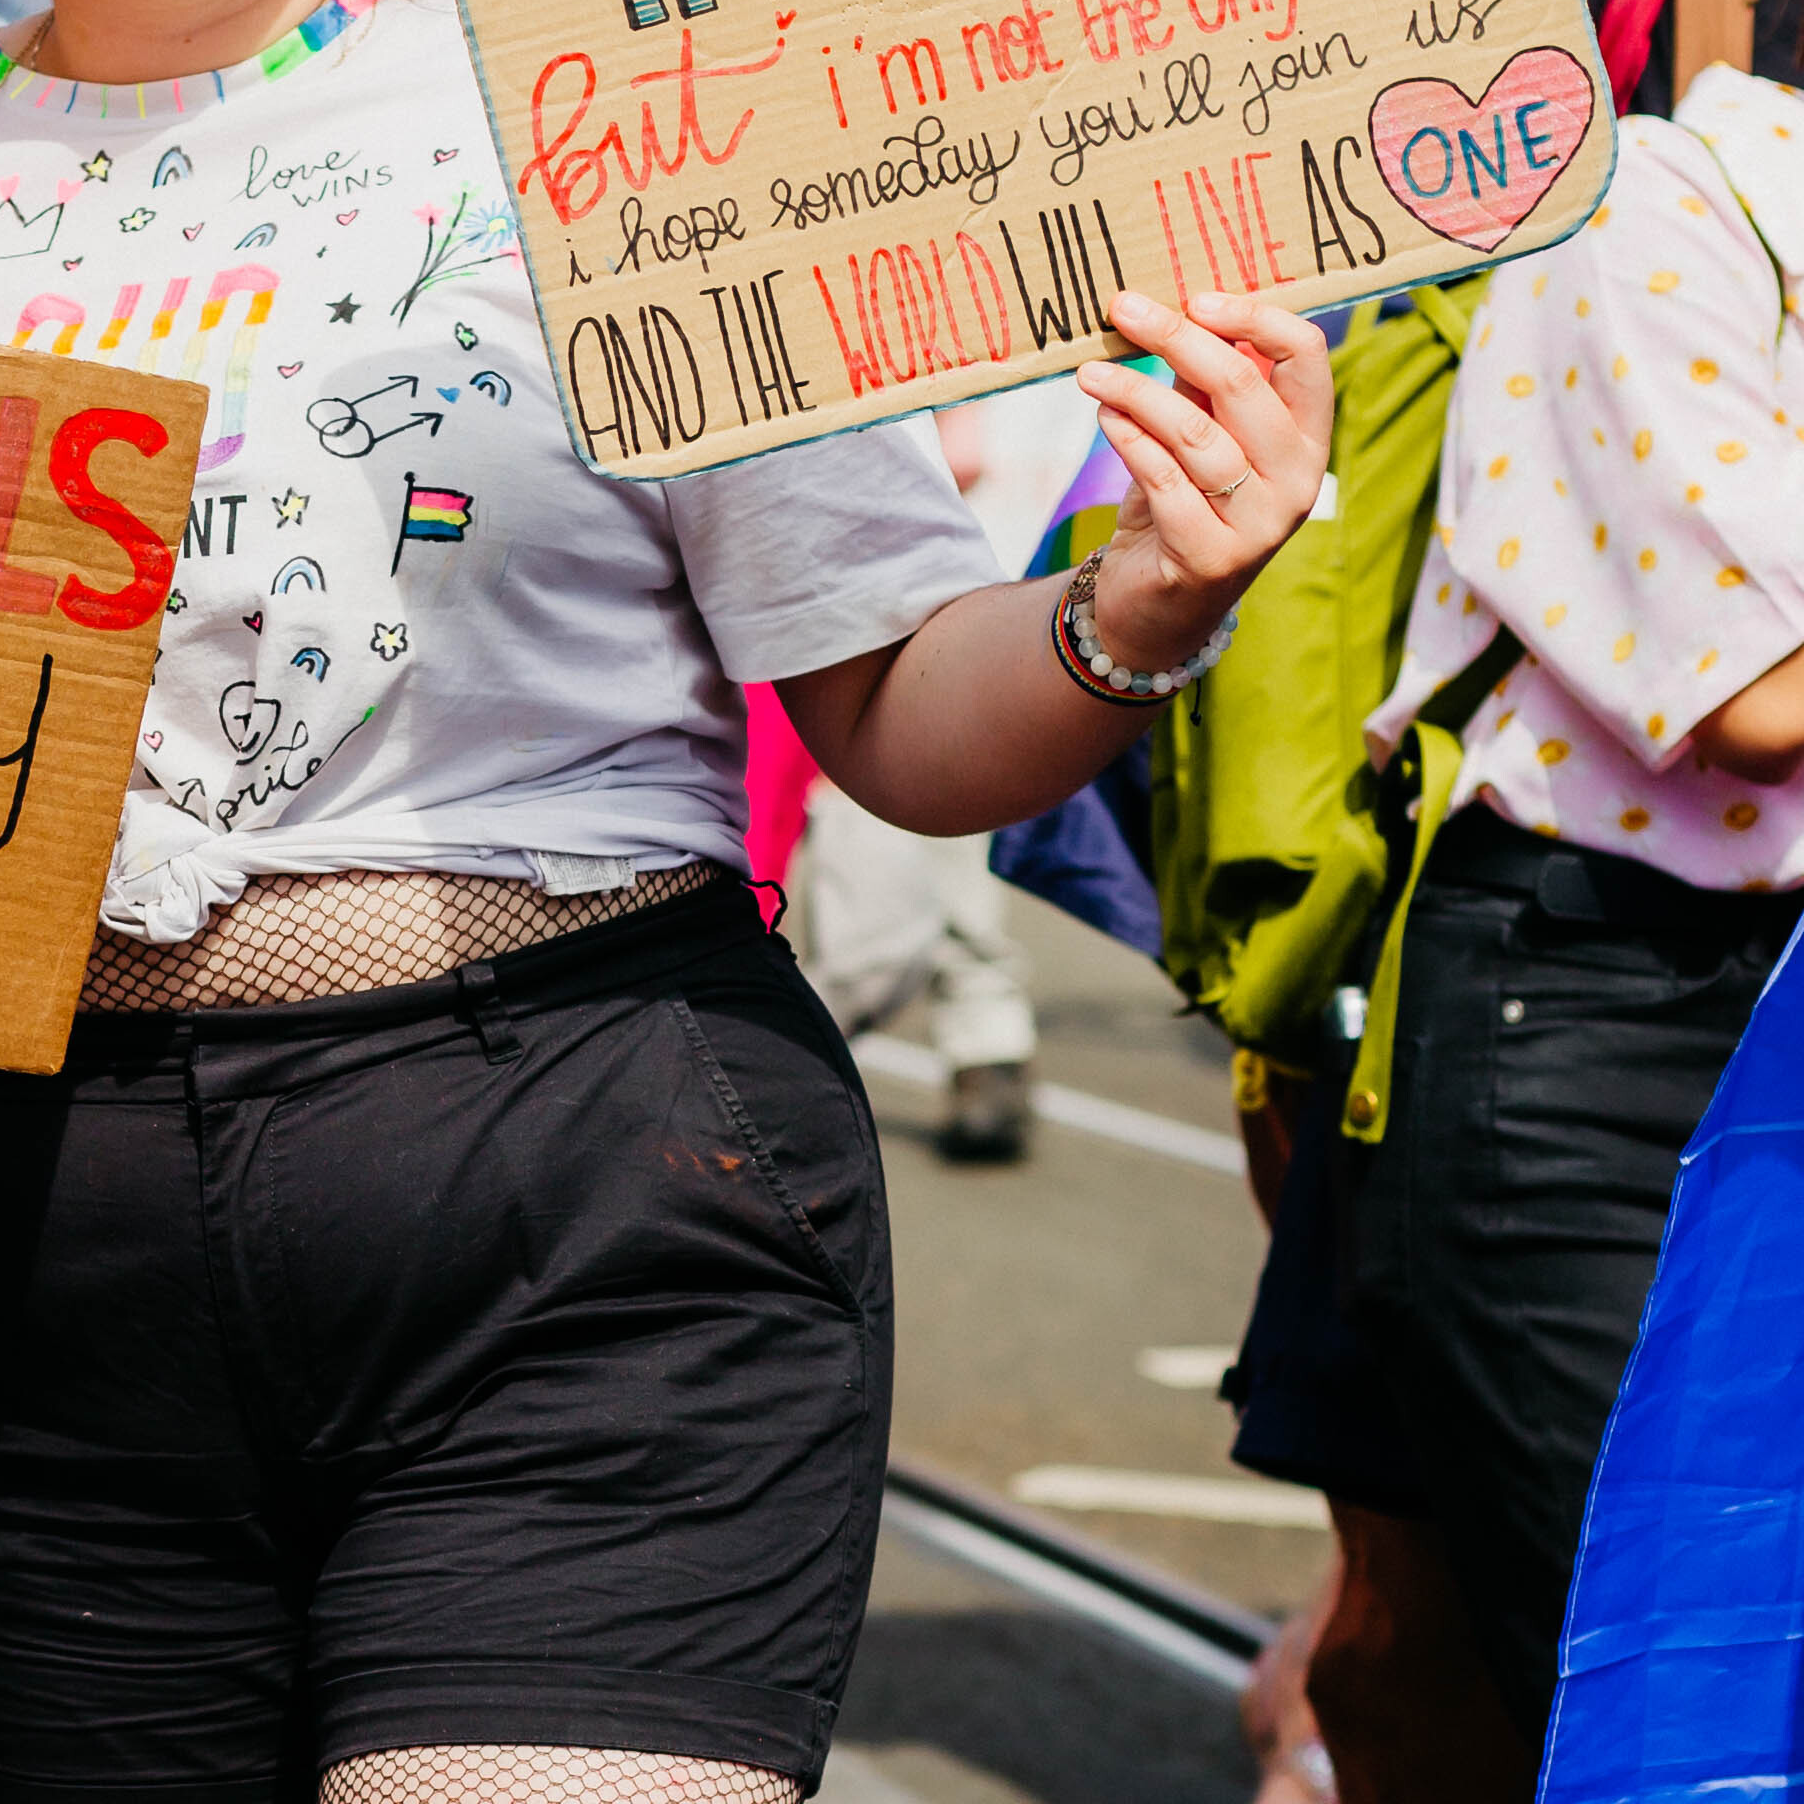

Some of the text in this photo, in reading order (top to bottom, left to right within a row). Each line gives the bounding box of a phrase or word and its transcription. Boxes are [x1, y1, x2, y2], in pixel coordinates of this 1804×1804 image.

[227, 143, 362, 200] love
[291, 164, 394, 208] WINS
[518, 28, 788, 226] but
[822, 36, 948, 129] i'm
[565, 239, 595, 289] i
[611, 197, 748, 286] hope
[770, 115, 1021, 231] someday
[1040, 61, 1226, 187] you'll
[1237, 20, 1370, 115] join
[568, 98, 1559, 461] AND THE WORLD WILL LIVE AS ONE
